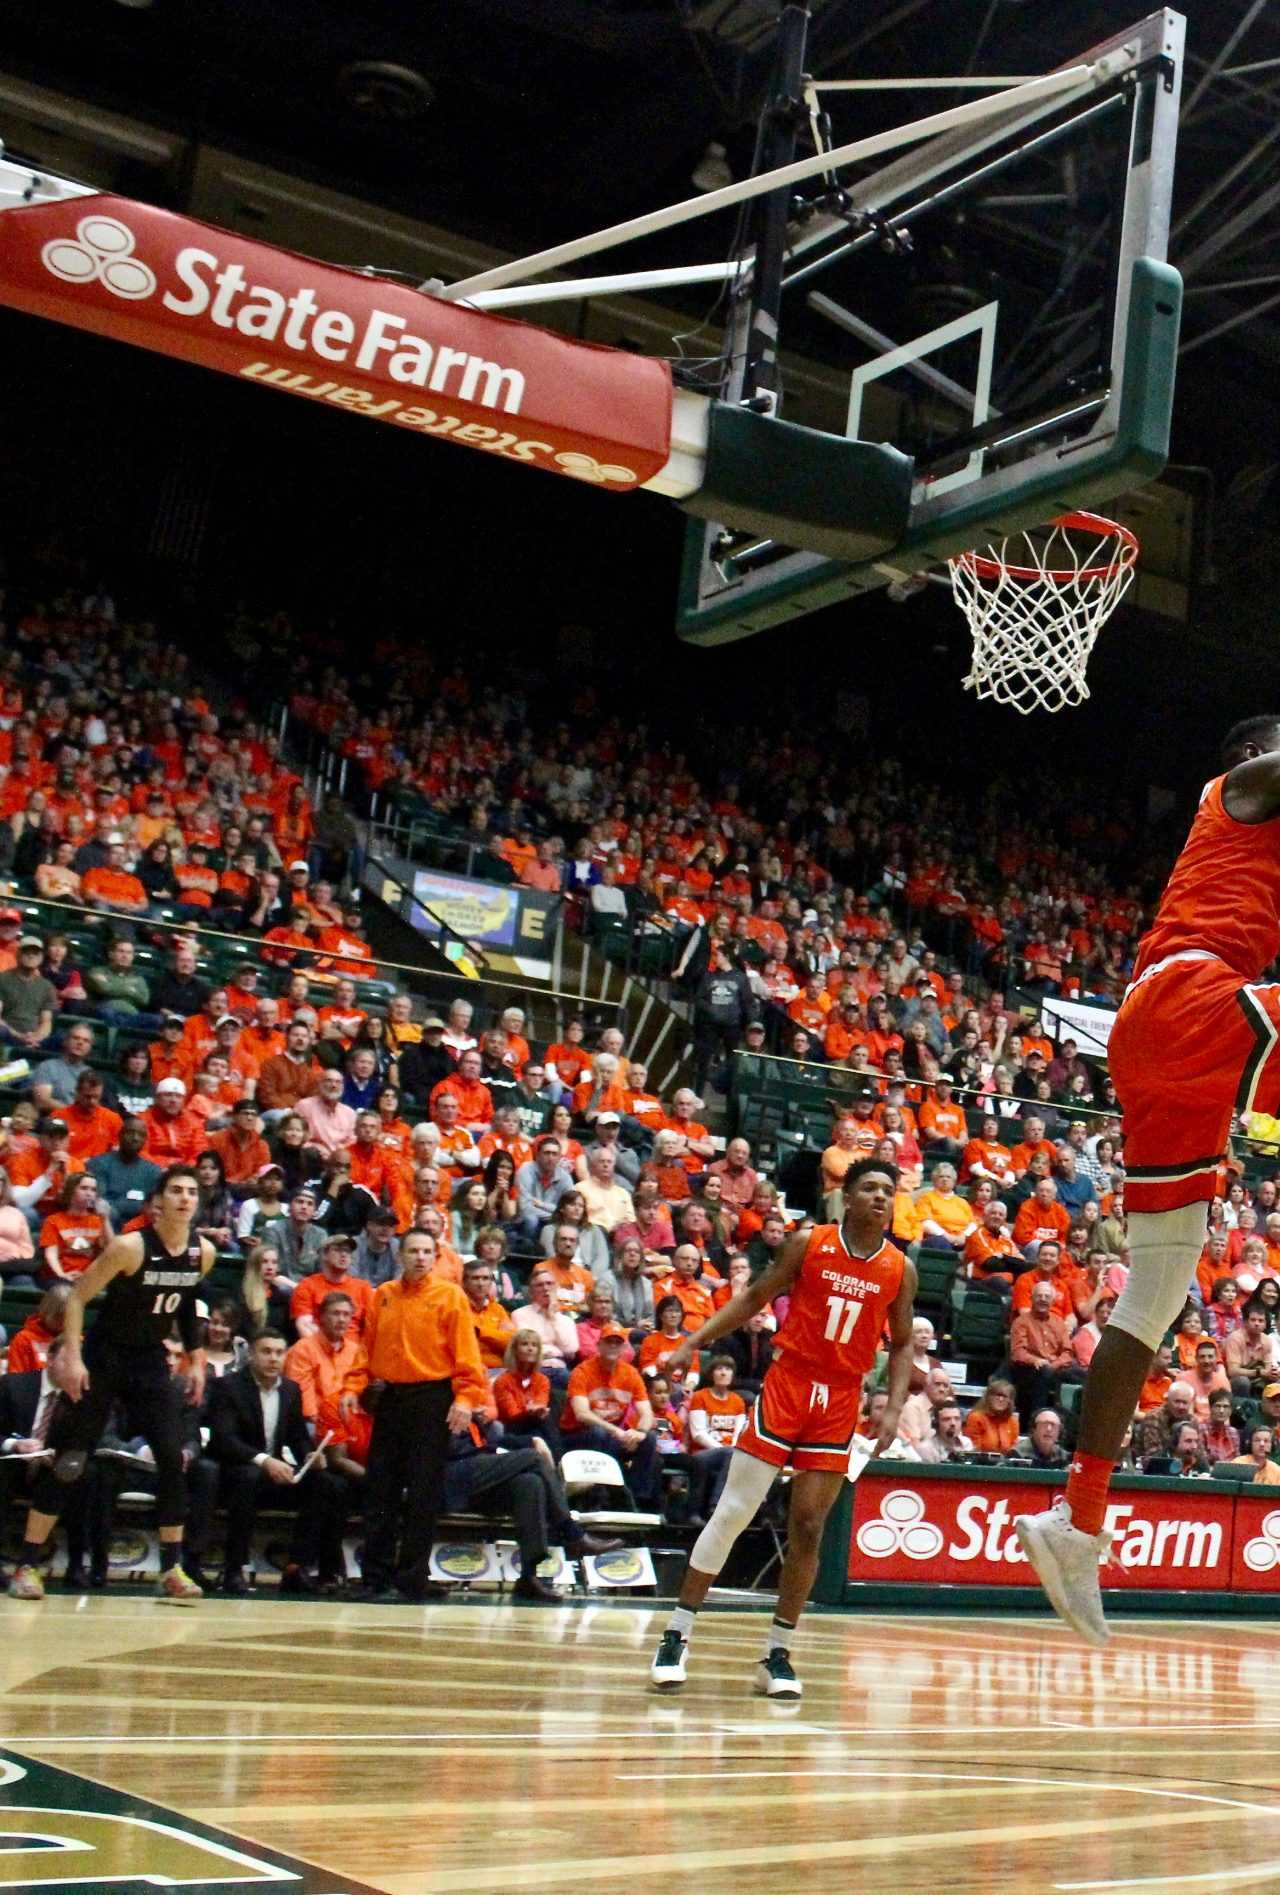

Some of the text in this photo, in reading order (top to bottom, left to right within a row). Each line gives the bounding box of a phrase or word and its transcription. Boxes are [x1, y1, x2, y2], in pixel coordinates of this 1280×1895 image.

[521, 908, 547, 940] E
[822, 1269, 881, 1294] COLORADO
[832, 1281, 866, 1299] STATE
[152, 1292, 182, 1315] 10
[824, 1296, 863, 1345] 11
